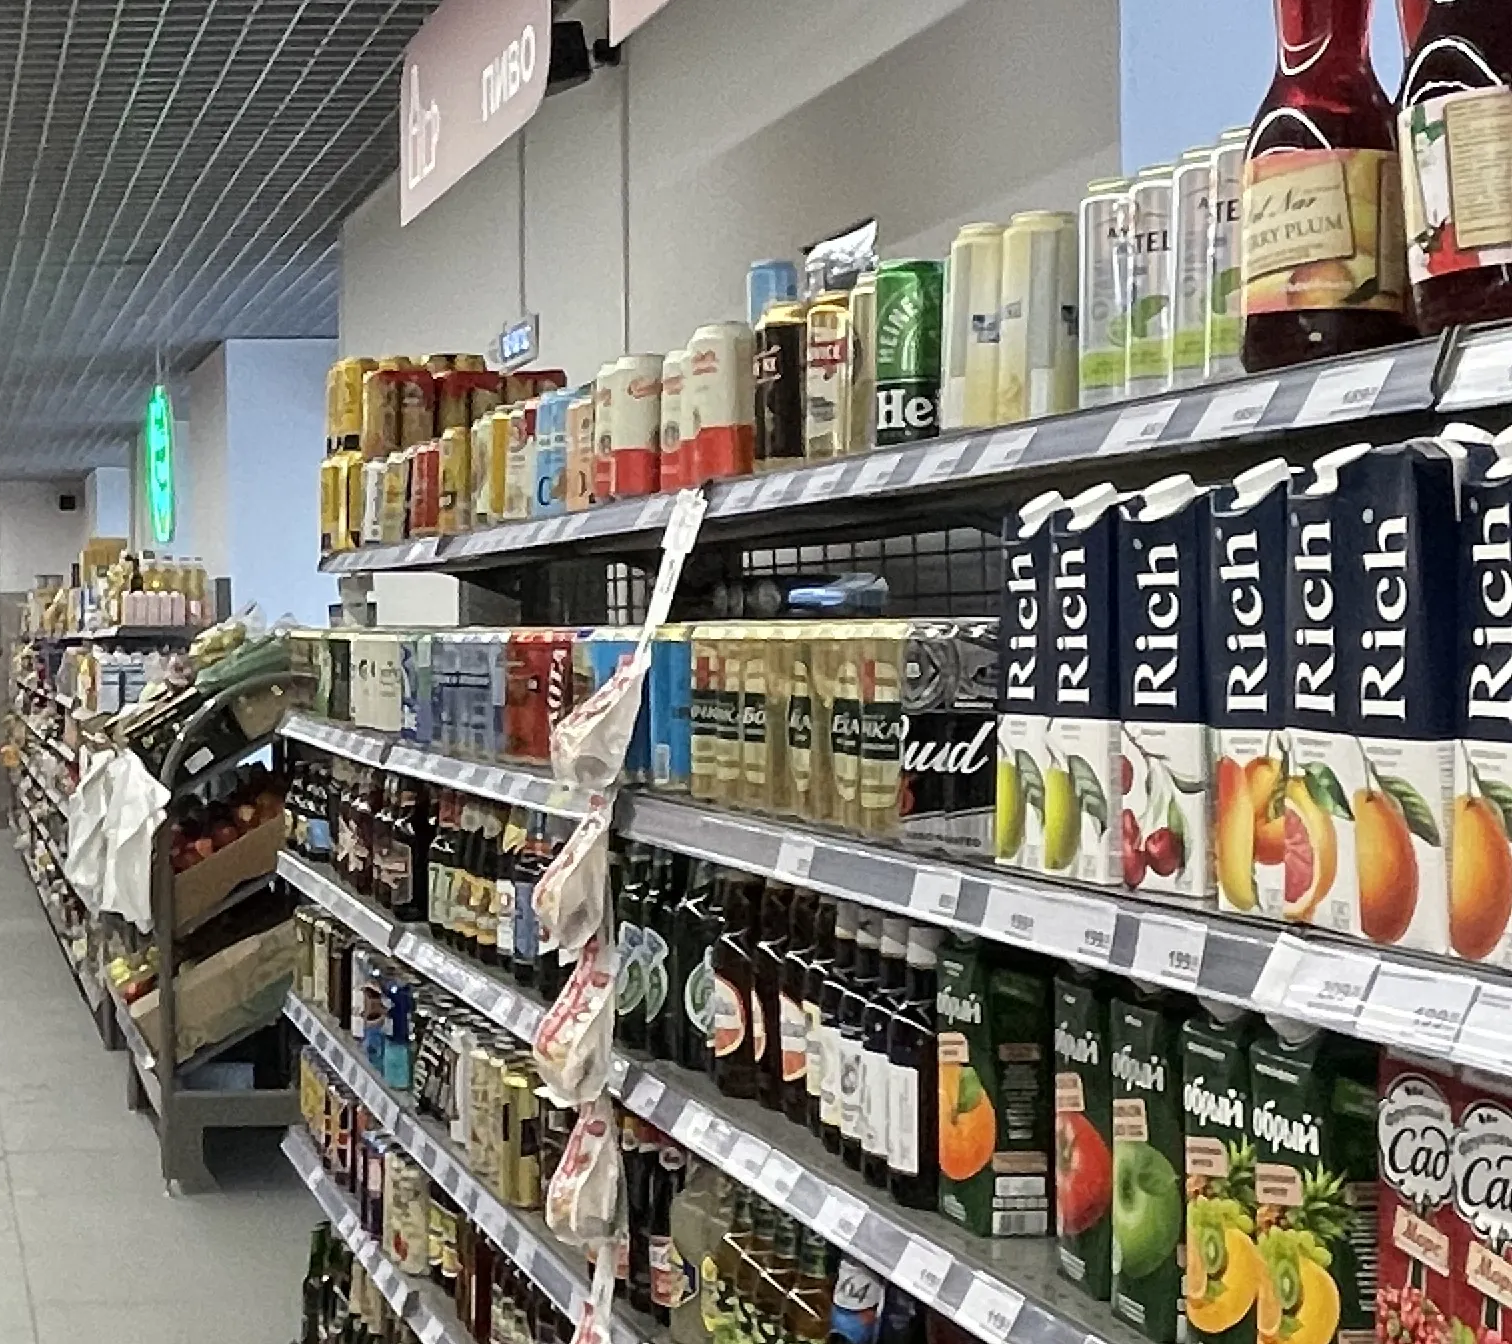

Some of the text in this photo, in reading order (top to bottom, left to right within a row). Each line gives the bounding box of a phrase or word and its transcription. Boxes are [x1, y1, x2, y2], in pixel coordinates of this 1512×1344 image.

[481, 23, 537, 124] ПИВО
[1284, 213, 1344, 239] PLUM
[1007, 551, 1039, 703] Rich
[1054, 545, 1090, 705] Rich
[1133, 541, 1181, 710] Rich
[1220, 528, 1268, 715] Rich
[1293, 519, 1336, 716] Rich
[1360, 513, 1410, 722] Rich
[1468, 501, 1512, 723] Rich
[1055, 1020, 1099, 1066] обрый
[1112, 1044, 1165, 1092] обрый
[1184, 1075, 1245, 1129] обрый
[1253, 1099, 1320, 1156] обрый
[1461, 1155, 1512, 1210] Са
